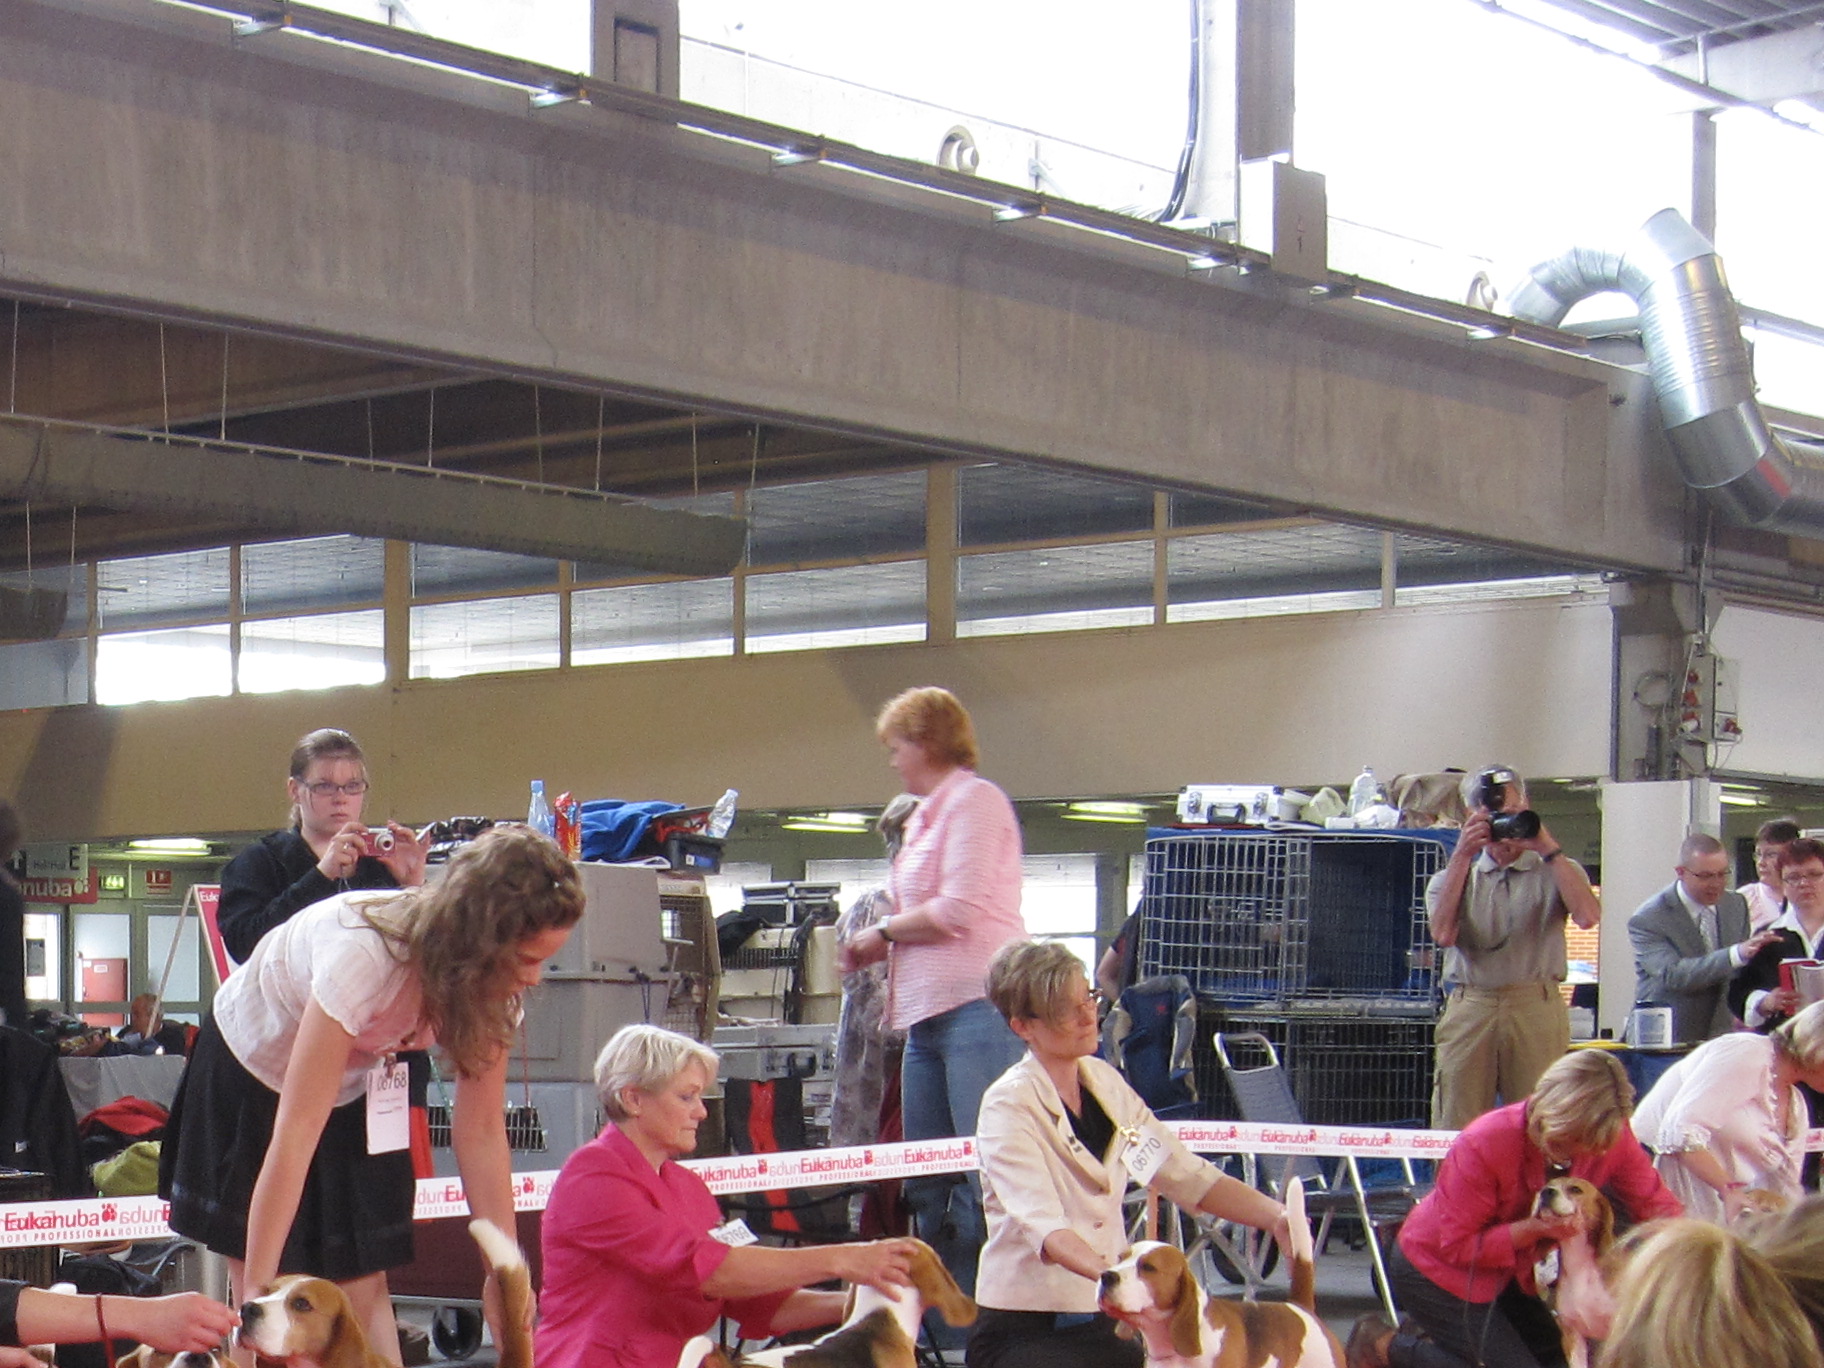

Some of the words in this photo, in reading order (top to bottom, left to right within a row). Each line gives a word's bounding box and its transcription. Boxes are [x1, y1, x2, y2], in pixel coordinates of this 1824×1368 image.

[69, 846, 80, 871] E
[801, 1153, 864, 1173] Eukanuba
[904, 1146, 963, 1164] Eukanuba
[1132, 1137, 1162, 1172] 06770
[5, 1208, 100, 1231] Eukanuba
[34, 1229, 116, 1241] PROFESSIONAL
